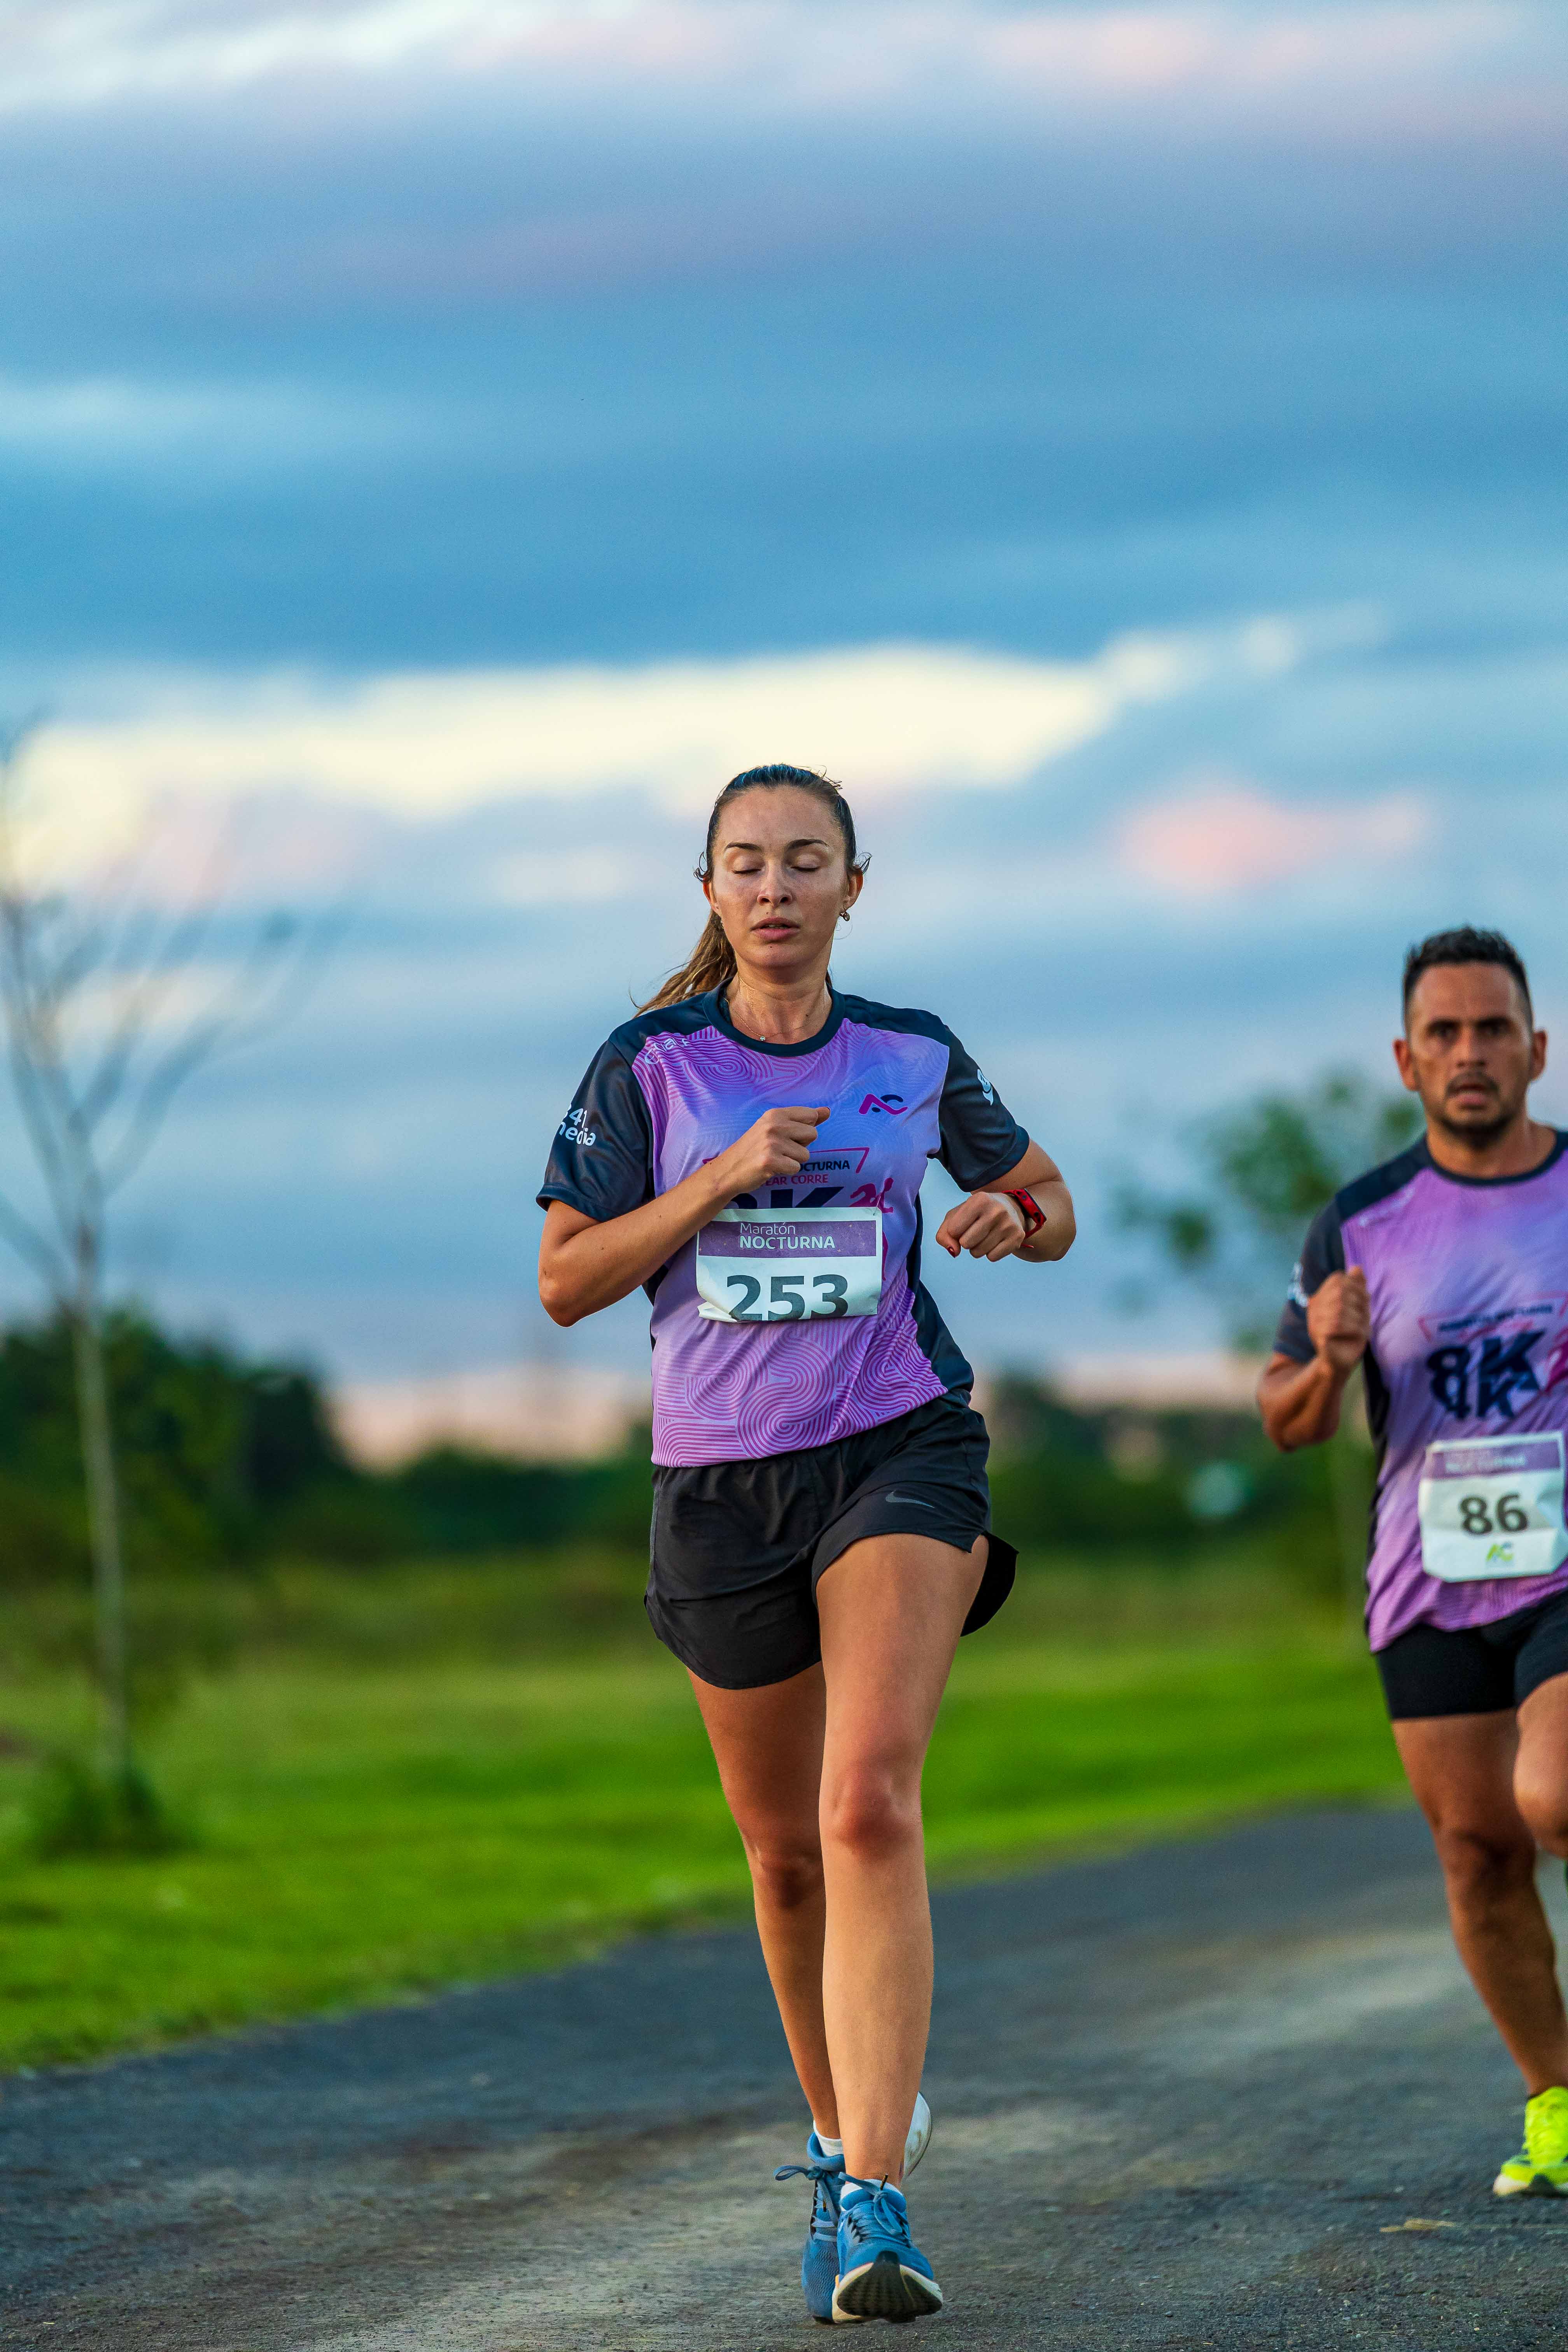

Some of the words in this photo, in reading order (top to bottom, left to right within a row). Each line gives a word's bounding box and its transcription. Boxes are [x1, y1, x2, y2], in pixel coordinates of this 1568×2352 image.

[765, 1175, 787, 1186] EAR
[791, 1174, 829, 1185] CORRE
[740, 1222, 796, 1235] Maratón
[740, 1235, 836, 1250] NOCTURNA
[726, 1274, 849, 1322] 253
[1459, 1493, 1528, 1536] 86
